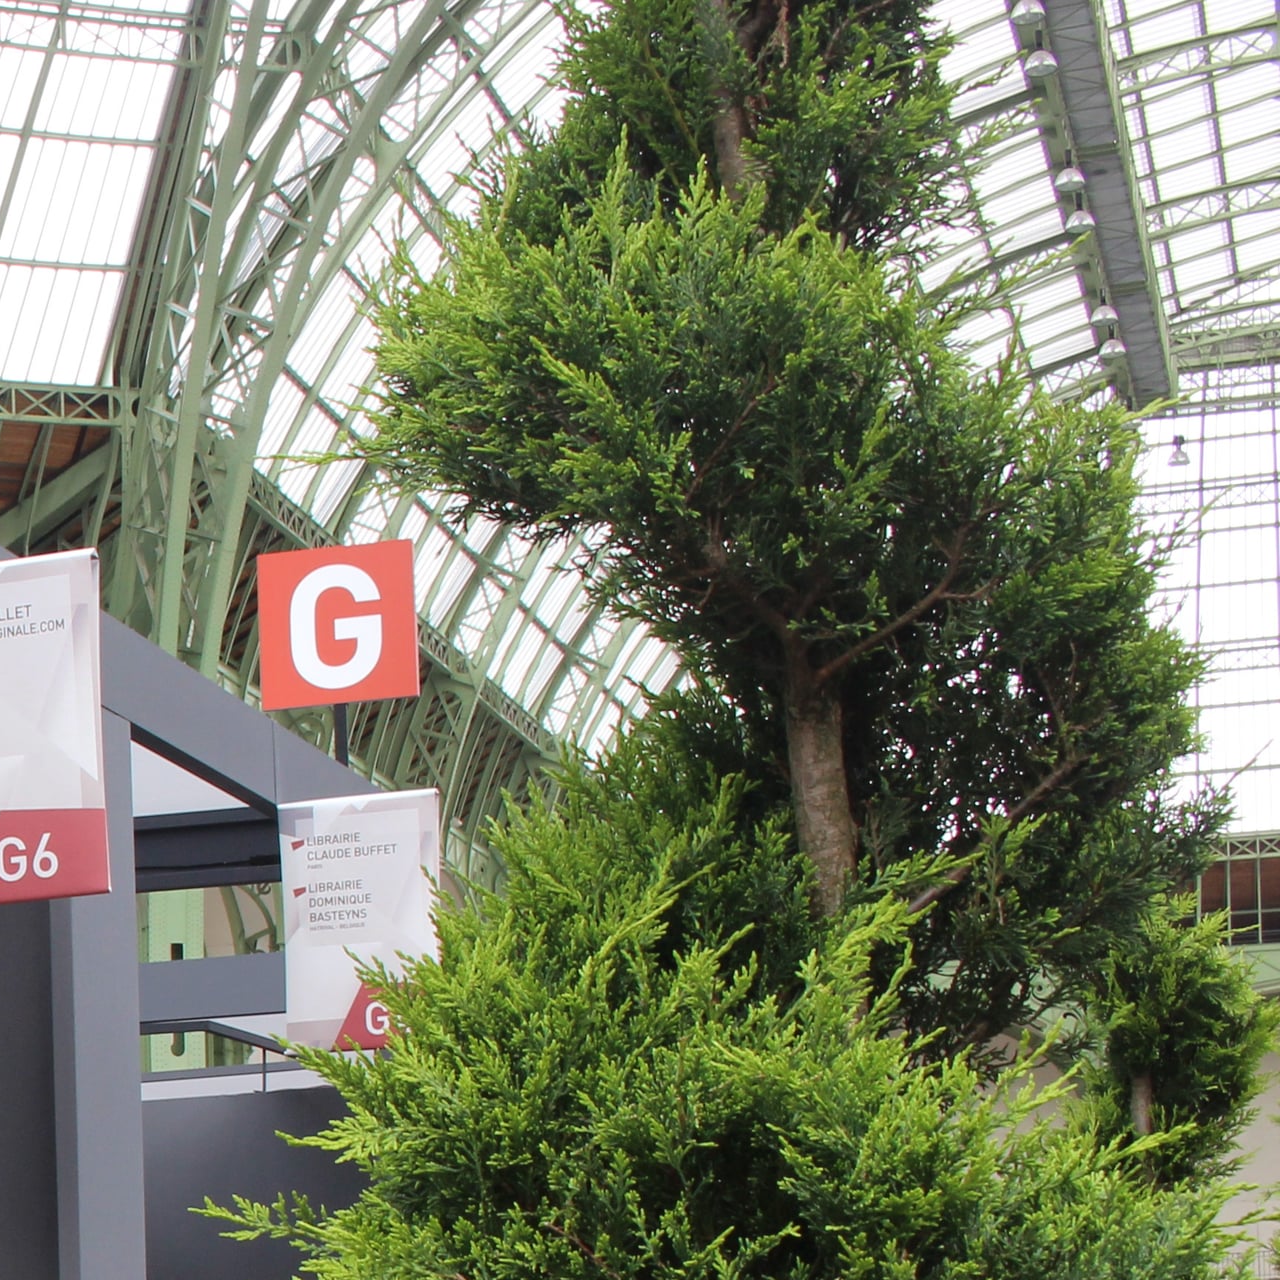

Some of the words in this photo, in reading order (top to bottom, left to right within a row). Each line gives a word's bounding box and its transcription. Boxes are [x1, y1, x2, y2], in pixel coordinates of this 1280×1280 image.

[289, 563, 383, 690] G
[306, 832, 361, 847] LIBRAIRIE
[307, 848, 352, 861] CLAUDE
[354, 843, 397, 857] BUFFET
[308, 879, 363, 894] LIBRAIRIE
[308, 893, 372, 908] DOMINIQUE
[309, 908, 368, 923] BASTEYNS
